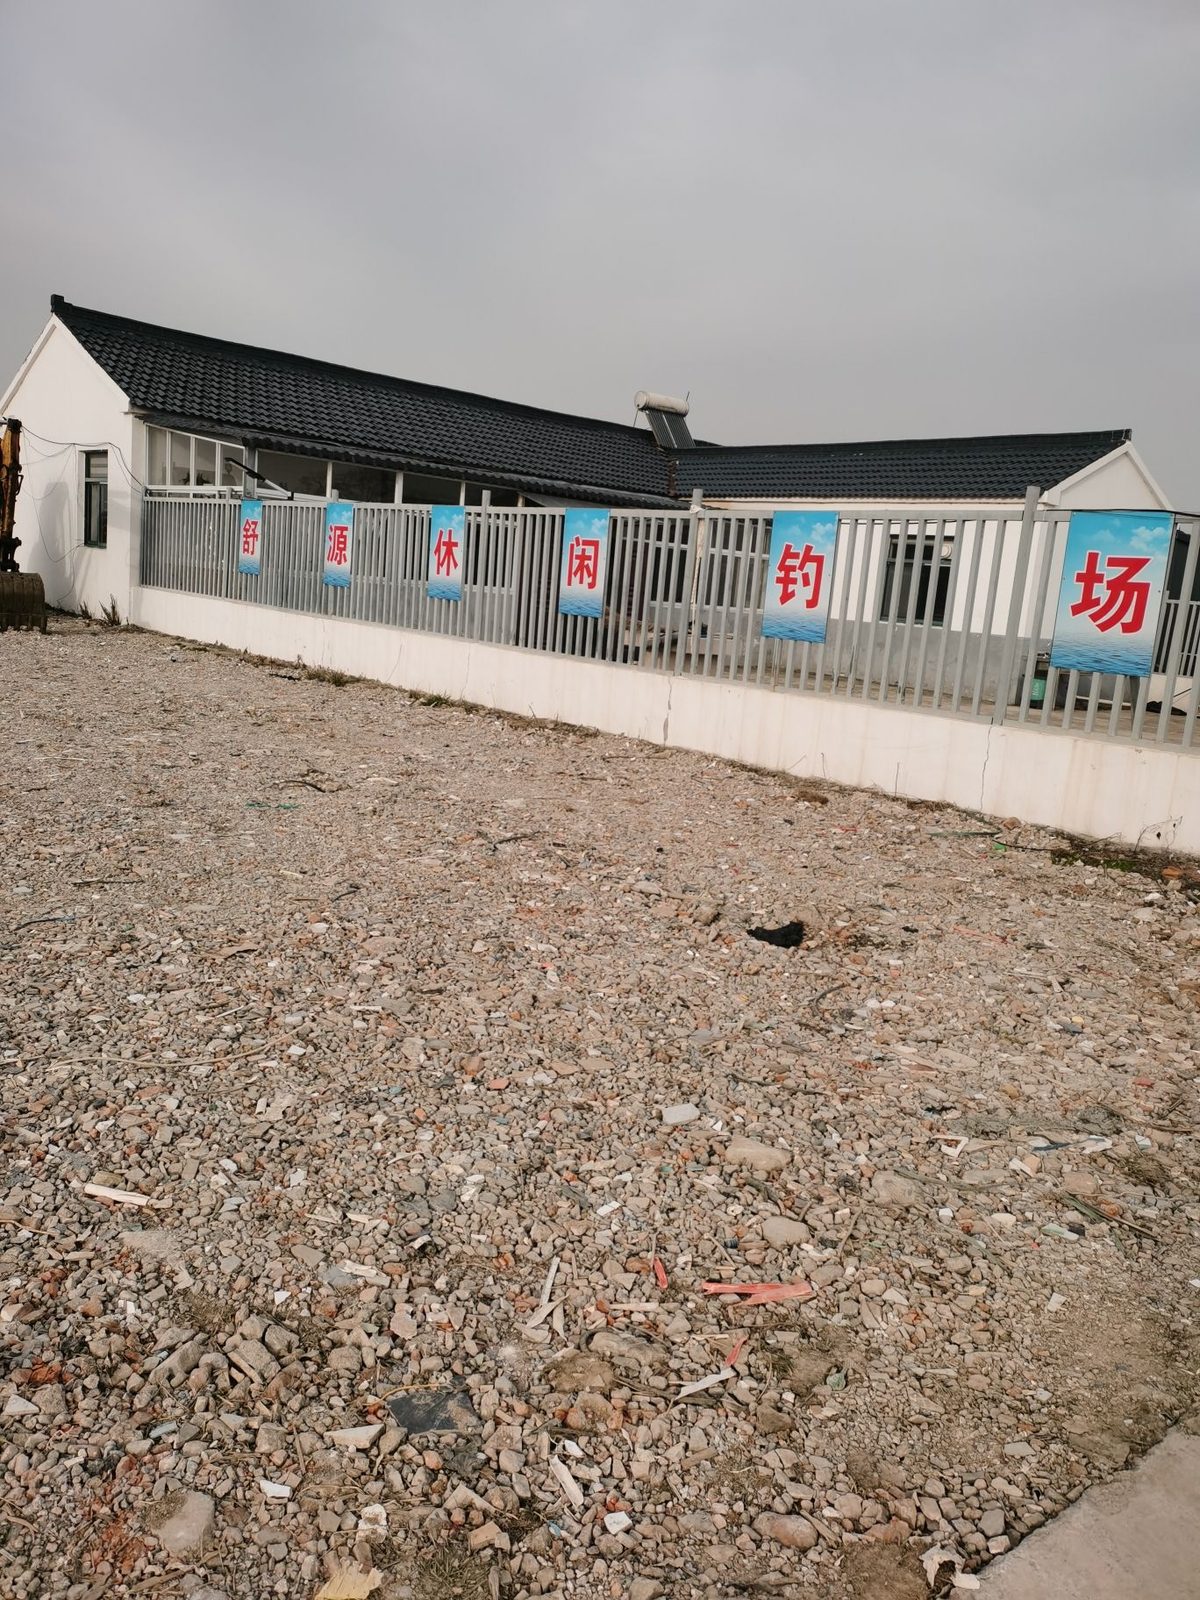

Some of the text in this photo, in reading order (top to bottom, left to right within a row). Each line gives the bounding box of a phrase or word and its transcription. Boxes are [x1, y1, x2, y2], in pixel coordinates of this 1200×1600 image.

[242, 519, 259, 555] 舒
[326, 524, 349, 565] 源
[433, 529, 459, 576] 休
[566, 536, 600, 590] 闲
[775, 543, 825, 609] 钓
[1070, 551, 1152, 634] 场
